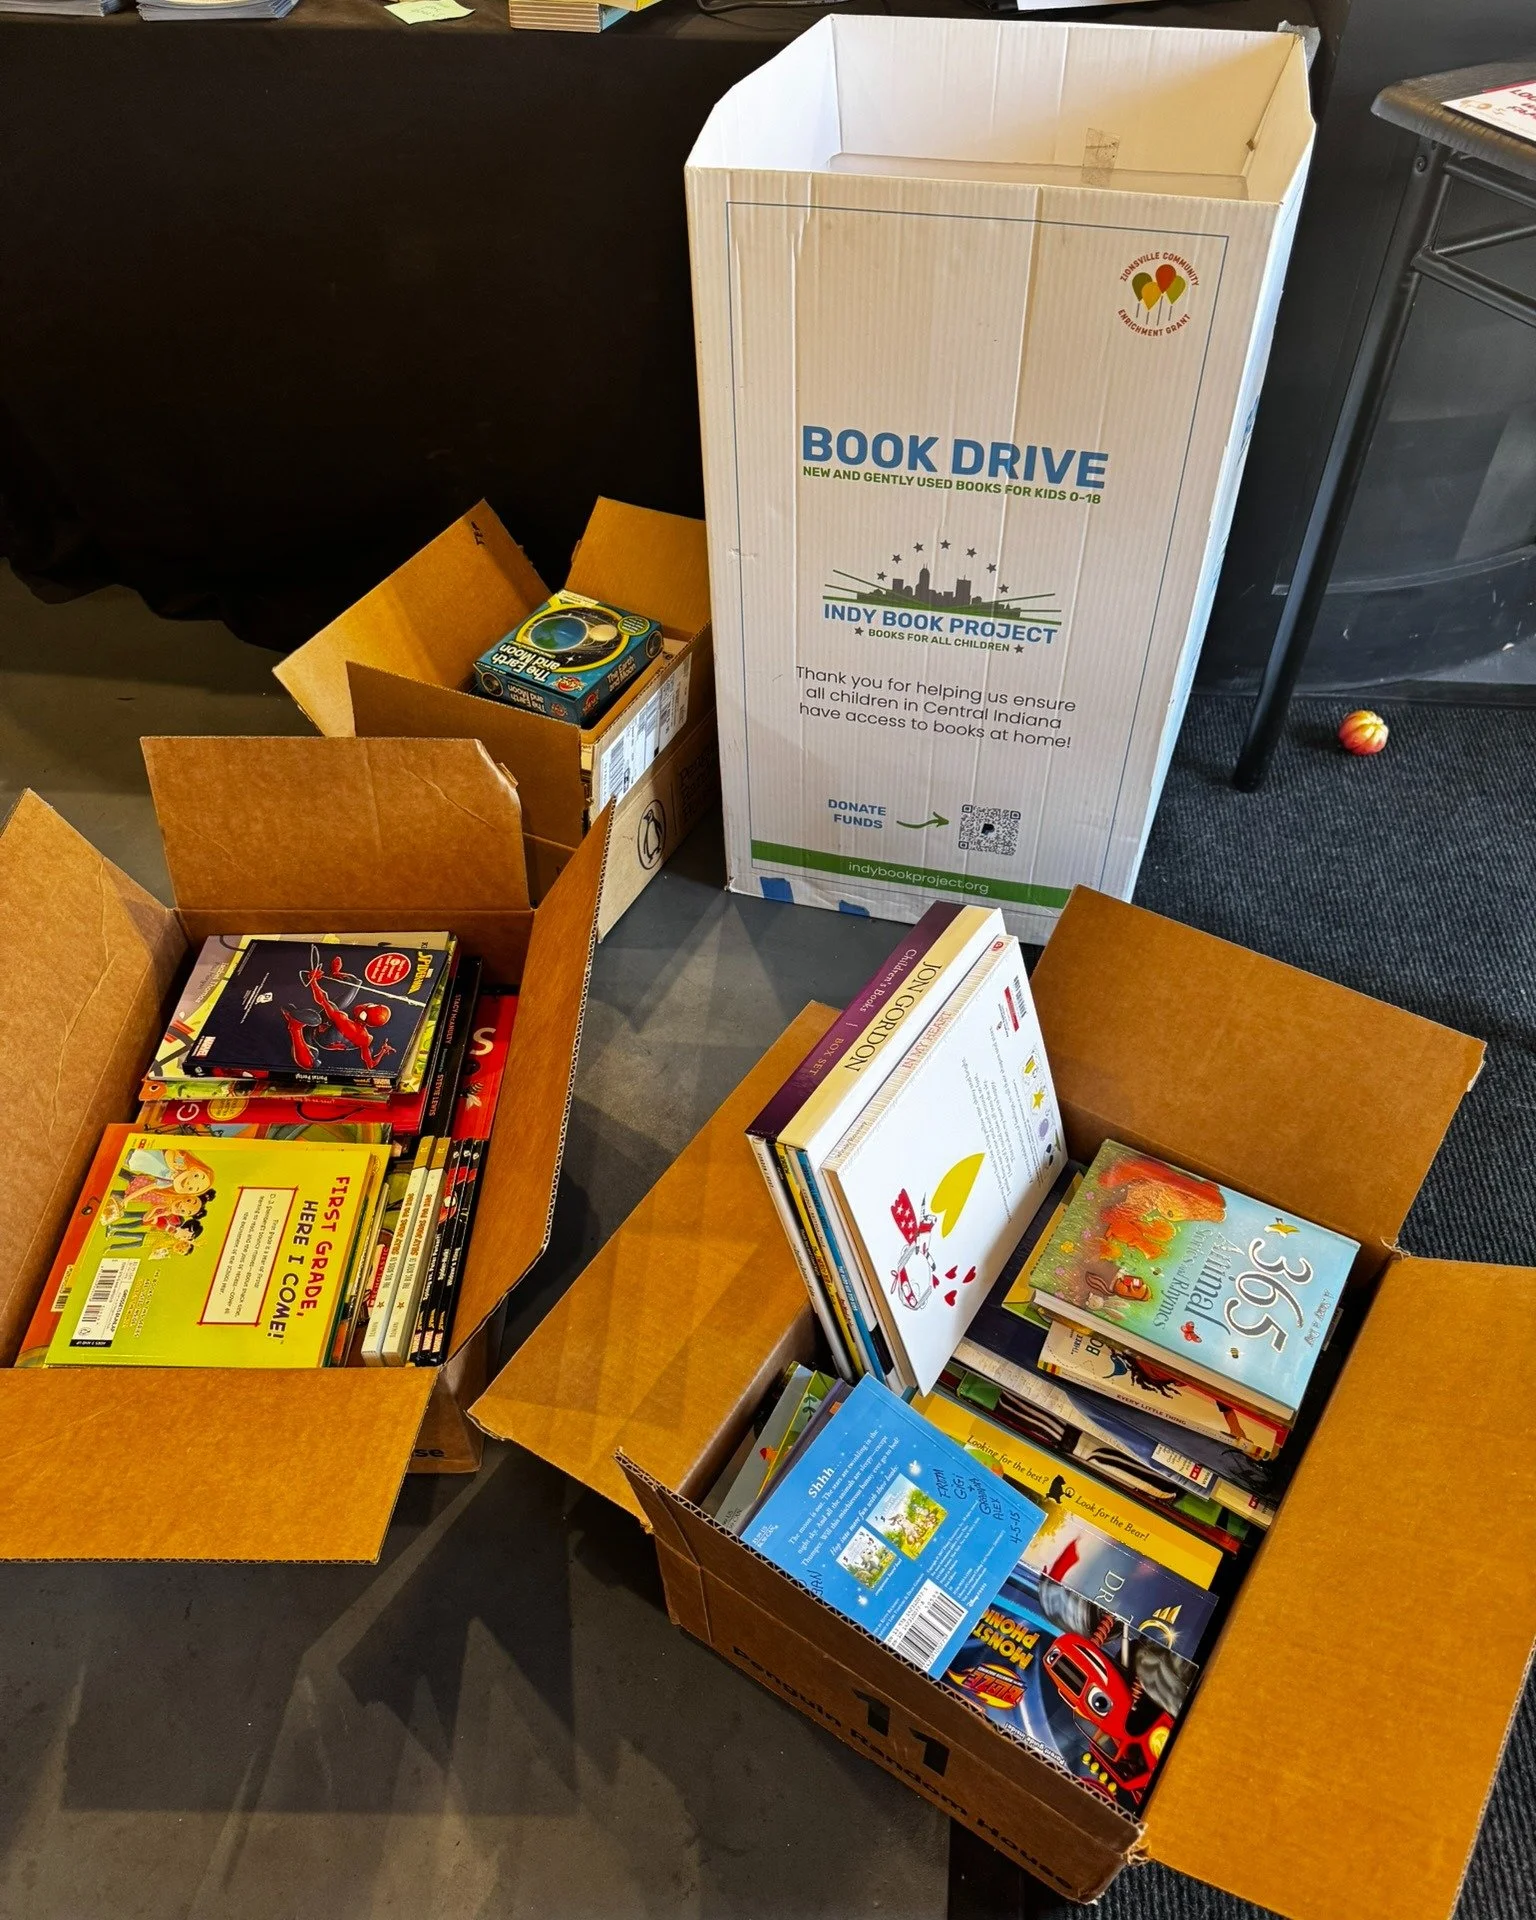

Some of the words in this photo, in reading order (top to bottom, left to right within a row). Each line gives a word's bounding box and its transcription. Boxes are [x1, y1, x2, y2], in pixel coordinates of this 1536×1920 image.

[1120, 252, 1160, 281] ZIONSVILLE
[1162, 252, 1199, 286] COMMUNITY
[1118, 309, 1163, 336] ENRICHMENT
[1166, 314, 1190, 334] GRANT
[803, 425, 939, 472] BOOK
[951, 438, 1109, 489] DRIVE
[803, 466, 831, 478] NEW
[833, 469, 860, 481] AND
[864, 472, 914, 486] GENTLY
[917, 477, 953, 489] USED
[956, 480, 1001, 494] BOOKS
[1005, 484, 1031, 497] FOR
[1034, 488, 1066, 501] KIDS
[1069, 492, 1101, 504] 0-18
[824, 603, 877, 624] INDY
[882, 610, 944, 632] BOOK
[950, 618, 1058, 644] PROJECT
[868, 628, 905, 640] BOOKS
[907, 633, 929, 643] FOR
[931, 636, 952, 646] ALL
[954, 638, 1010, 652] CHILDREN
[492, 652, 527, 674] Earth
[498, 643, 536, 666] Moon
[537, 656, 561, 671] and
[530, 667, 551, 682] The
[796, 666, 846, 684] Thank
[851, 675, 882, 689] you
[888, 678, 911, 692] for
[917, 681, 982, 704] helping
[988, 692, 1008, 704] us
[1014, 695, 1076, 712] ensure
[806, 687, 824, 699] all
[830, 690, 898, 709] children
[904, 698, 918, 711] in
[923, 701, 988, 720] Central
[994, 710, 1062, 729] Indiana
[800, 702, 840, 719] have
[845, 711, 906, 728] access
[912, 718, 928, 730] to
[934, 720, 984, 738] books
[990, 730, 1008, 740] at
[1013, 730, 1071, 748] home!
[828, 799, 886, 816] DONATE
[834, 814, 883, 829] FUNDS
[848, 862, 989, 895] indybookproject.org
[879, 949, 917, 987] Children's
[907, 961, 942, 993] JON
[860, 988, 885, 1012] Books
[826, 1038, 844, 1057] BOX
[845, 995, 915, 1072] GORDON
[903, 1058, 916, 1069] IN
[914, 1042, 928, 1058] MY
[927, 1012, 951, 1042] HEART
[810, 1059, 826, 1075] SET
[433, 1074, 443, 1095] STEVIE
[428, 1096, 439, 1116] LEWIS
[321, 1176, 350, 1232] FIRST
[293, 1200, 318, 1246] HERE
[288, 1255, 304, 1265] I
[1188, 1225, 1213, 1264] Stories
[297, 1241, 333, 1317] GRADE,
[1184, 1232, 1245, 1335] Animal
[1224, 1238, 1313, 1352] 365
[267, 1273, 299, 1338] COME!
[1153, 1277, 1190, 1330] Rhymes
[1117, 1394, 1140, 1407] EVERY
[1141, 1404, 1164, 1417] LITTLE
[1165, 1412, 1187, 1425] THING
[966, 1435, 998, 1459] Looking
[999, 1454, 1013, 1465] for
[1013, 1462, 1026, 1472] the
[1026, 1466, 1049, 1485] best?
[1010, 1511, 1022, 1544] 4-5-15
[1076, 1496, 1096, 1512] Look
[1095, 1508, 1109, 1520] for
[1109, 1513, 1125, 1527] the
[1125, 1523, 1150, 1541] Bear!
[962, 1671, 1027, 1704] BLAZE
[1005, 1723, 1026, 1740] inside!
[1026, 1736, 1045, 1752] guide
[732, 1646, 842, 1728] Penguin
[850, 1728, 968, 1817] Random
[976, 1817, 1073, 1890] House
[1044, 1749, 1066, 1766] Parent
